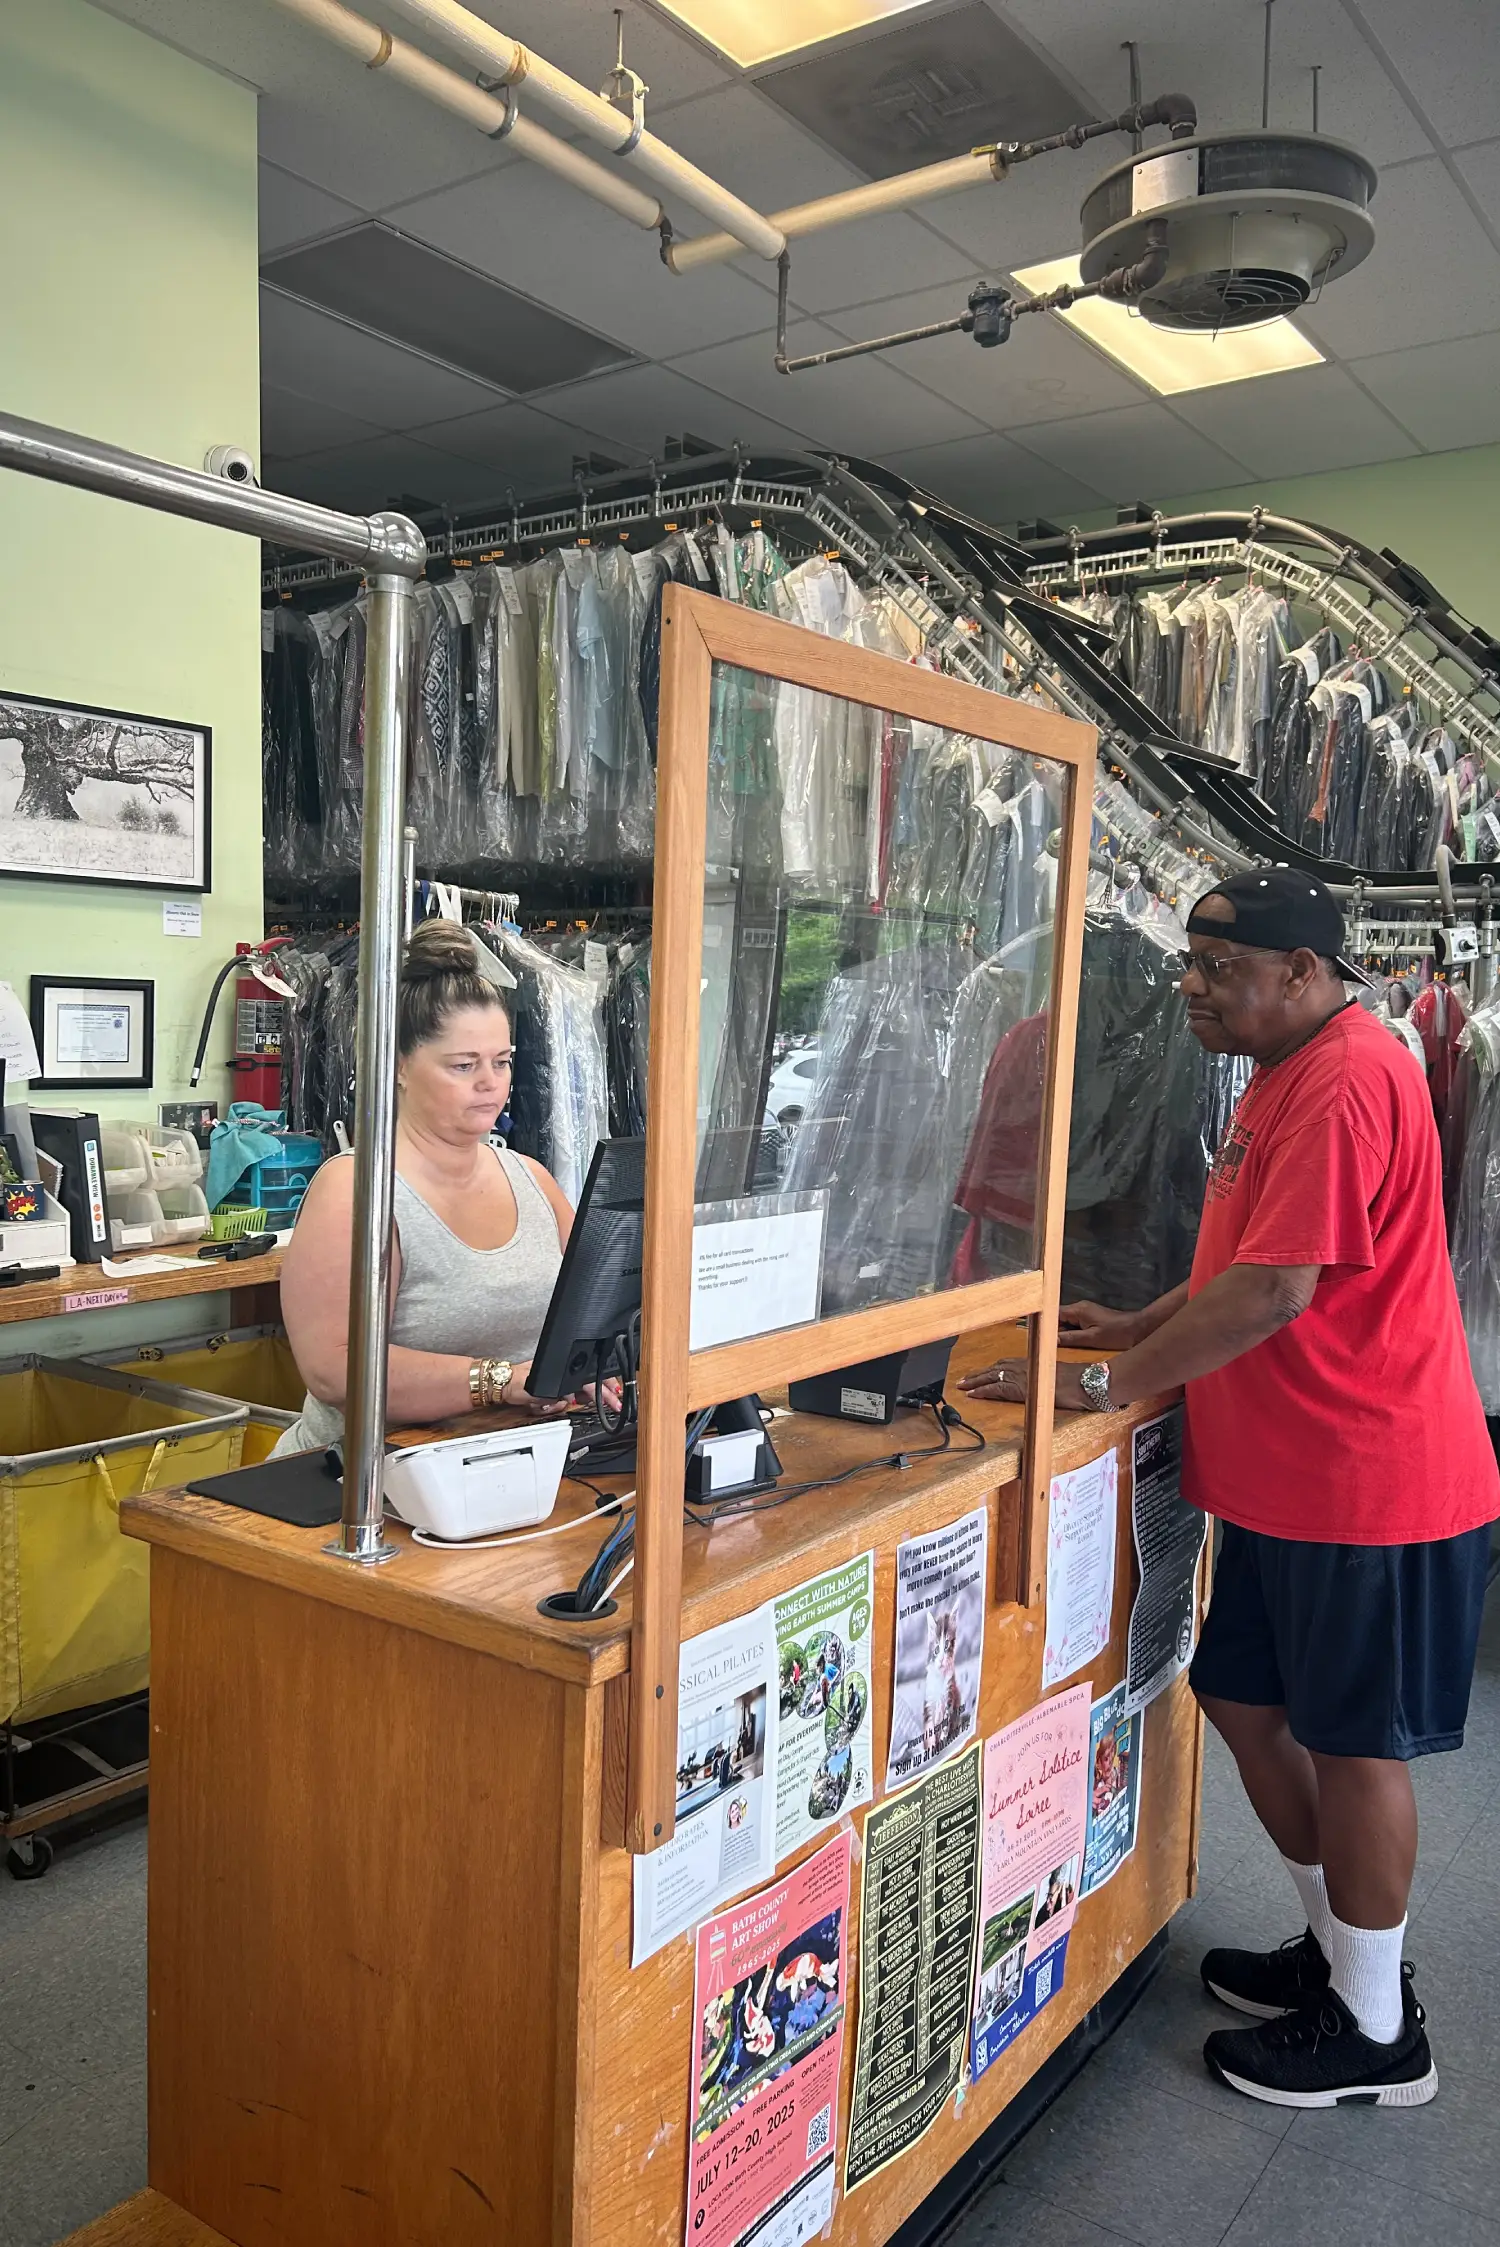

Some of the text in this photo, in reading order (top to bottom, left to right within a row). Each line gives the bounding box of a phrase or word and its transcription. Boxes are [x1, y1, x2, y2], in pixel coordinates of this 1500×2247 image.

[911, 1562, 922, 1576] year
[924, 1555, 938, 1569] NEVER
[913, 1547, 921, 1558] you
[922, 1541, 936, 1552] know
[774, 1563, 867, 1620] ONNECT WITH NATURE
[924, 1570, 942, 1586] comedy
[793, 1608, 816, 1626] EARTH
[817, 1595, 846, 1615] SUMMER
[847, 1582, 865, 1600] CAMPS
[852, 1605, 867, 1623] AGES
[911, 1600, 924, 1614] make
[925, 1595, 933, 1608] the
[934, 1589, 950, 1604] mistake
[679, 1661, 720, 1693] SSICAL
[723, 1641, 764, 1674] PILATES
[1069, 1692, 1085, 1706] SPCA
[785, 1734, 796, 1749] FOR
[1017, 1731, 1052, 1762] JOIN US FOR
[895, 1750, 930, 1776] Sign up at
[924, 1754, 975, 1794] THE BEST LIVE MUSIC
[925, 1765, 975, 1802] IN CHARLOTTESVILLE
[989, 1747, 1082, 1819] Summer Solstice
[664, 1829, 709, 1859] INFORMATION
[878, 1810, 919, 1844] JEFFERSON
[997, 1854, 1014, 1872] EARLY
[1015, 1834, 1043, 1860] MOUNTAIN
[1043, 1814, 1072, 1842] VINEYARDS
[732, 1888, 790, 1934] BATH COUNTY
[732, 1910, 779, 1950] ART SHOW
[737, 1939, 780, 1976] 1965-2025
[713, 2106, 724, 2118] FOR
[741, 2083, 748, 2092] OF
[748, 2058, 779, 2086] CELEBRATING
[779, 2038, 805, 2062] CREATIVITY
[805, 2030, 815, 2042] AND
[815, 2009, 842, 2034] COMMUNITY
[696, 2046, 836, 2167] FREE ADMISSION FREE PARKING OPEN TO ALL
[696, 2160, 721, 2200] JULY
[766, 2100, 795, 2135] 2025
[849, 2156, 863, 2174] RENT
[864, 2146, 875, 2157] THE
[876, 2121, 911, 2151] JEFFERSON
[923, 2098, 935, 2115] YOUR
[708, 2130, 793, 2208] LOCATION: Bath County High School
